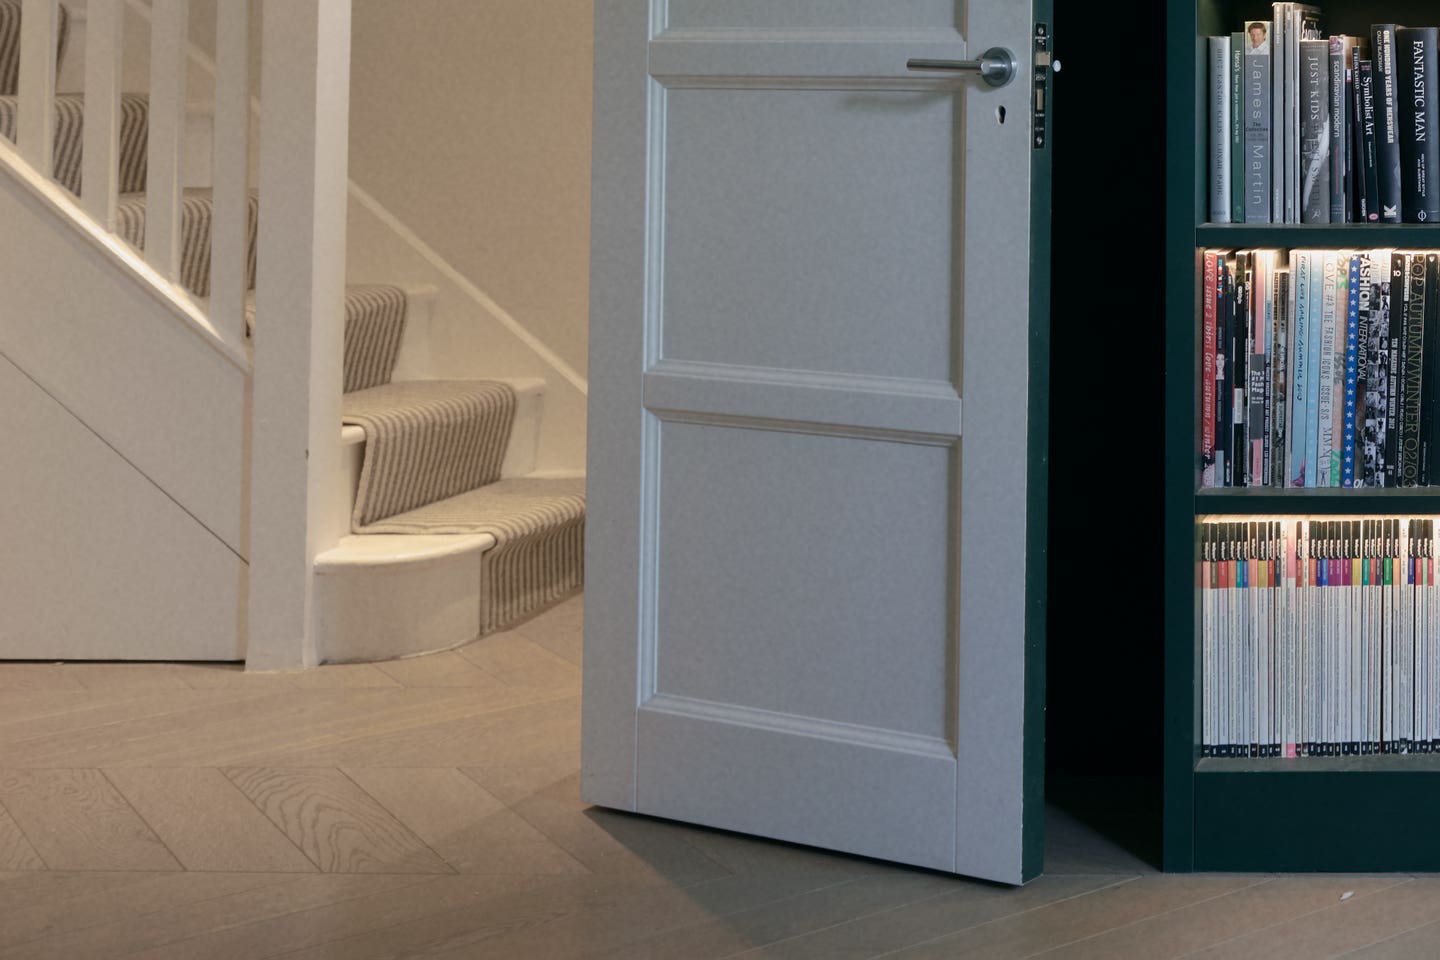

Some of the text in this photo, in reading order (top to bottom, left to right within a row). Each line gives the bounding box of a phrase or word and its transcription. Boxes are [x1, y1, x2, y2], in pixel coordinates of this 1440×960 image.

[1252, 59, 1265, 205] James Martin
[1308, 56, 1320, 121] JUST KIDS
[1333, 60, 1341, 138] scandinavian modern
[1361, 76, 1374, 136] Symbolist Art
[1383, 30, 1394, 144] ONE HUNDRED YEARS OF MENSWEAR
[1412, 40, 1426, 142] FANTASTIC MAN
[1357, 253, 1370, 382] FASHION INTERNATIONAL
